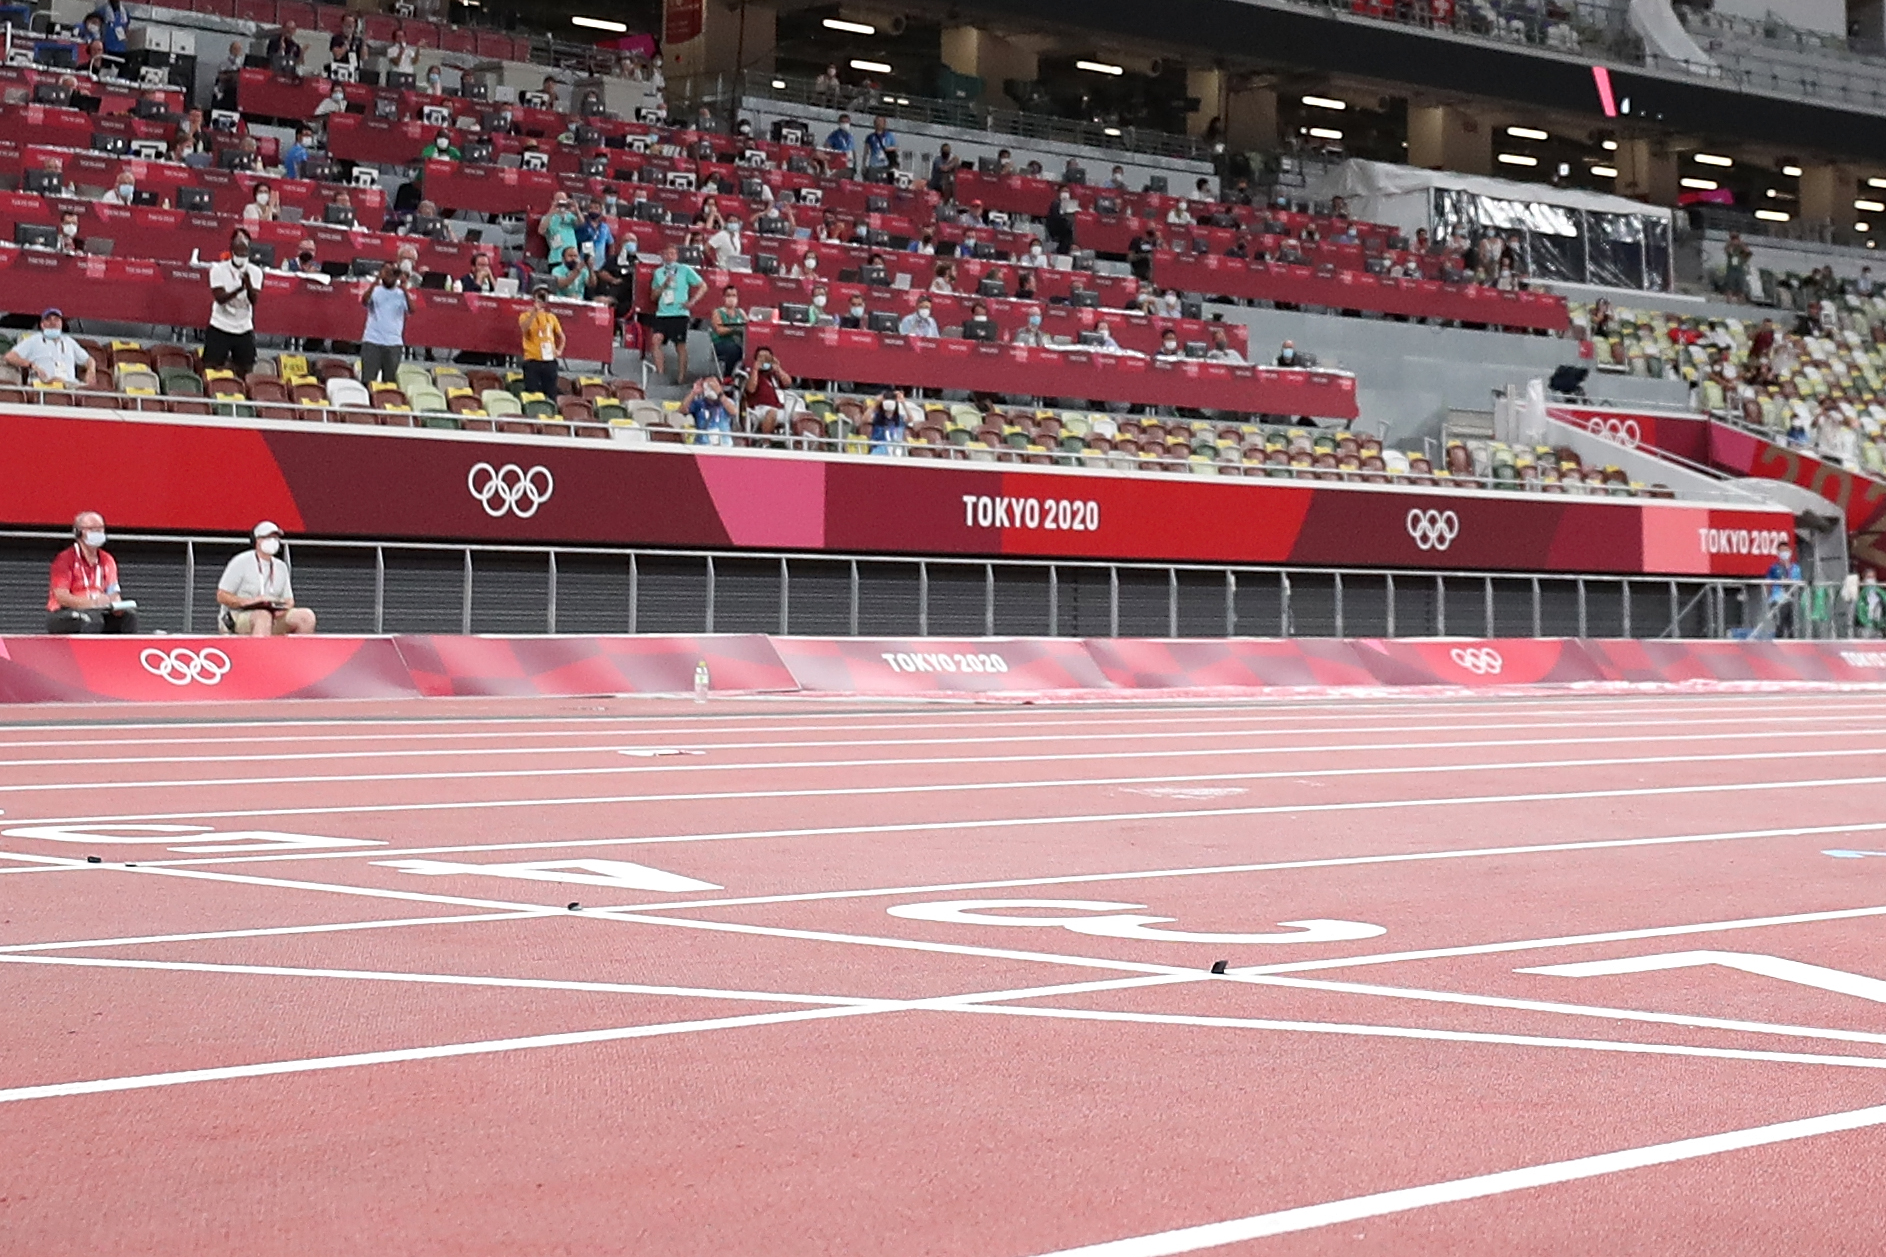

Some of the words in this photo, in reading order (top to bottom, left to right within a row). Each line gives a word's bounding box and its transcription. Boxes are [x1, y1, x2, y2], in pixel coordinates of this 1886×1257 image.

[962, 495, 1040, 529] TOKYO
[1043, 499, 1099, 531] 2020
[1699, 528, 1750, 554] TOKYO
[881, 653, 956, 673] TOKYO
[953, 653, 1008, 673] 2020
[1840, 651, 1880, 667] TOKYO
[886, 899, 1387, 943] 3
